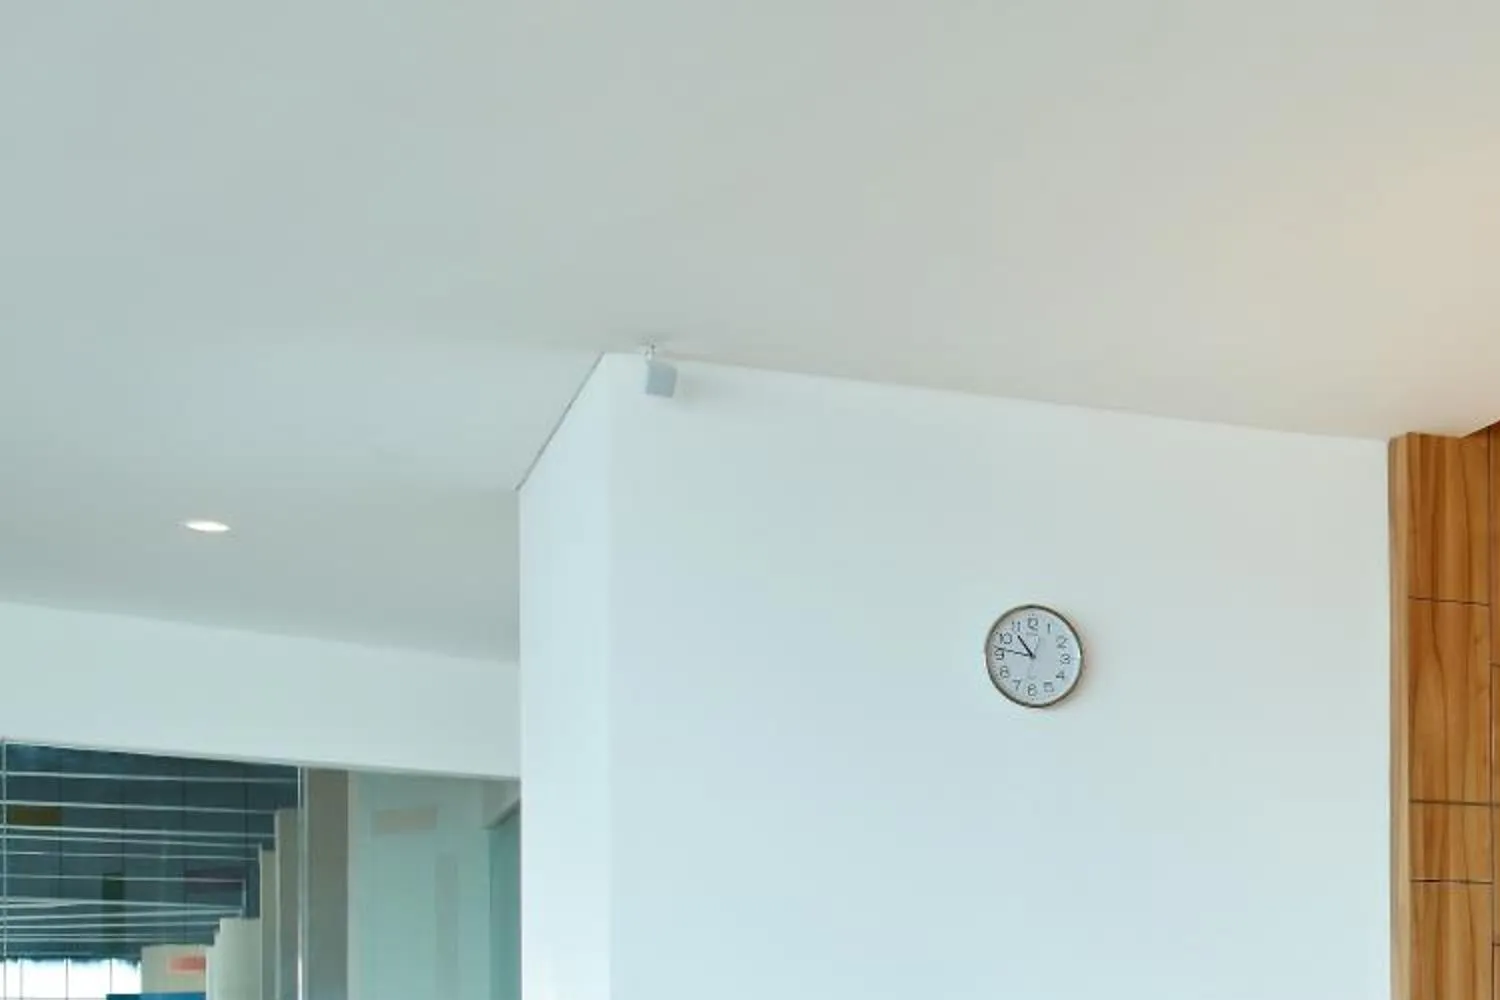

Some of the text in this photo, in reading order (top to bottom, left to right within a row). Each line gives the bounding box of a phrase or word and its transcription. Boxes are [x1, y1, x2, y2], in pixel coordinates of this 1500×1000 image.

[1000, 633, 1012, 644] 10
[1057, 636, 1068, 648] 2
[995, 647, 1004, 660] 9
[1060, 654, 1071, 665] 3
[1000, 666, 1009, 678] 8
[1013, 680, 1021, 690] 7
[1028, 684, 1037, 696] 6
[1044, 682, 1054, 692] 5
